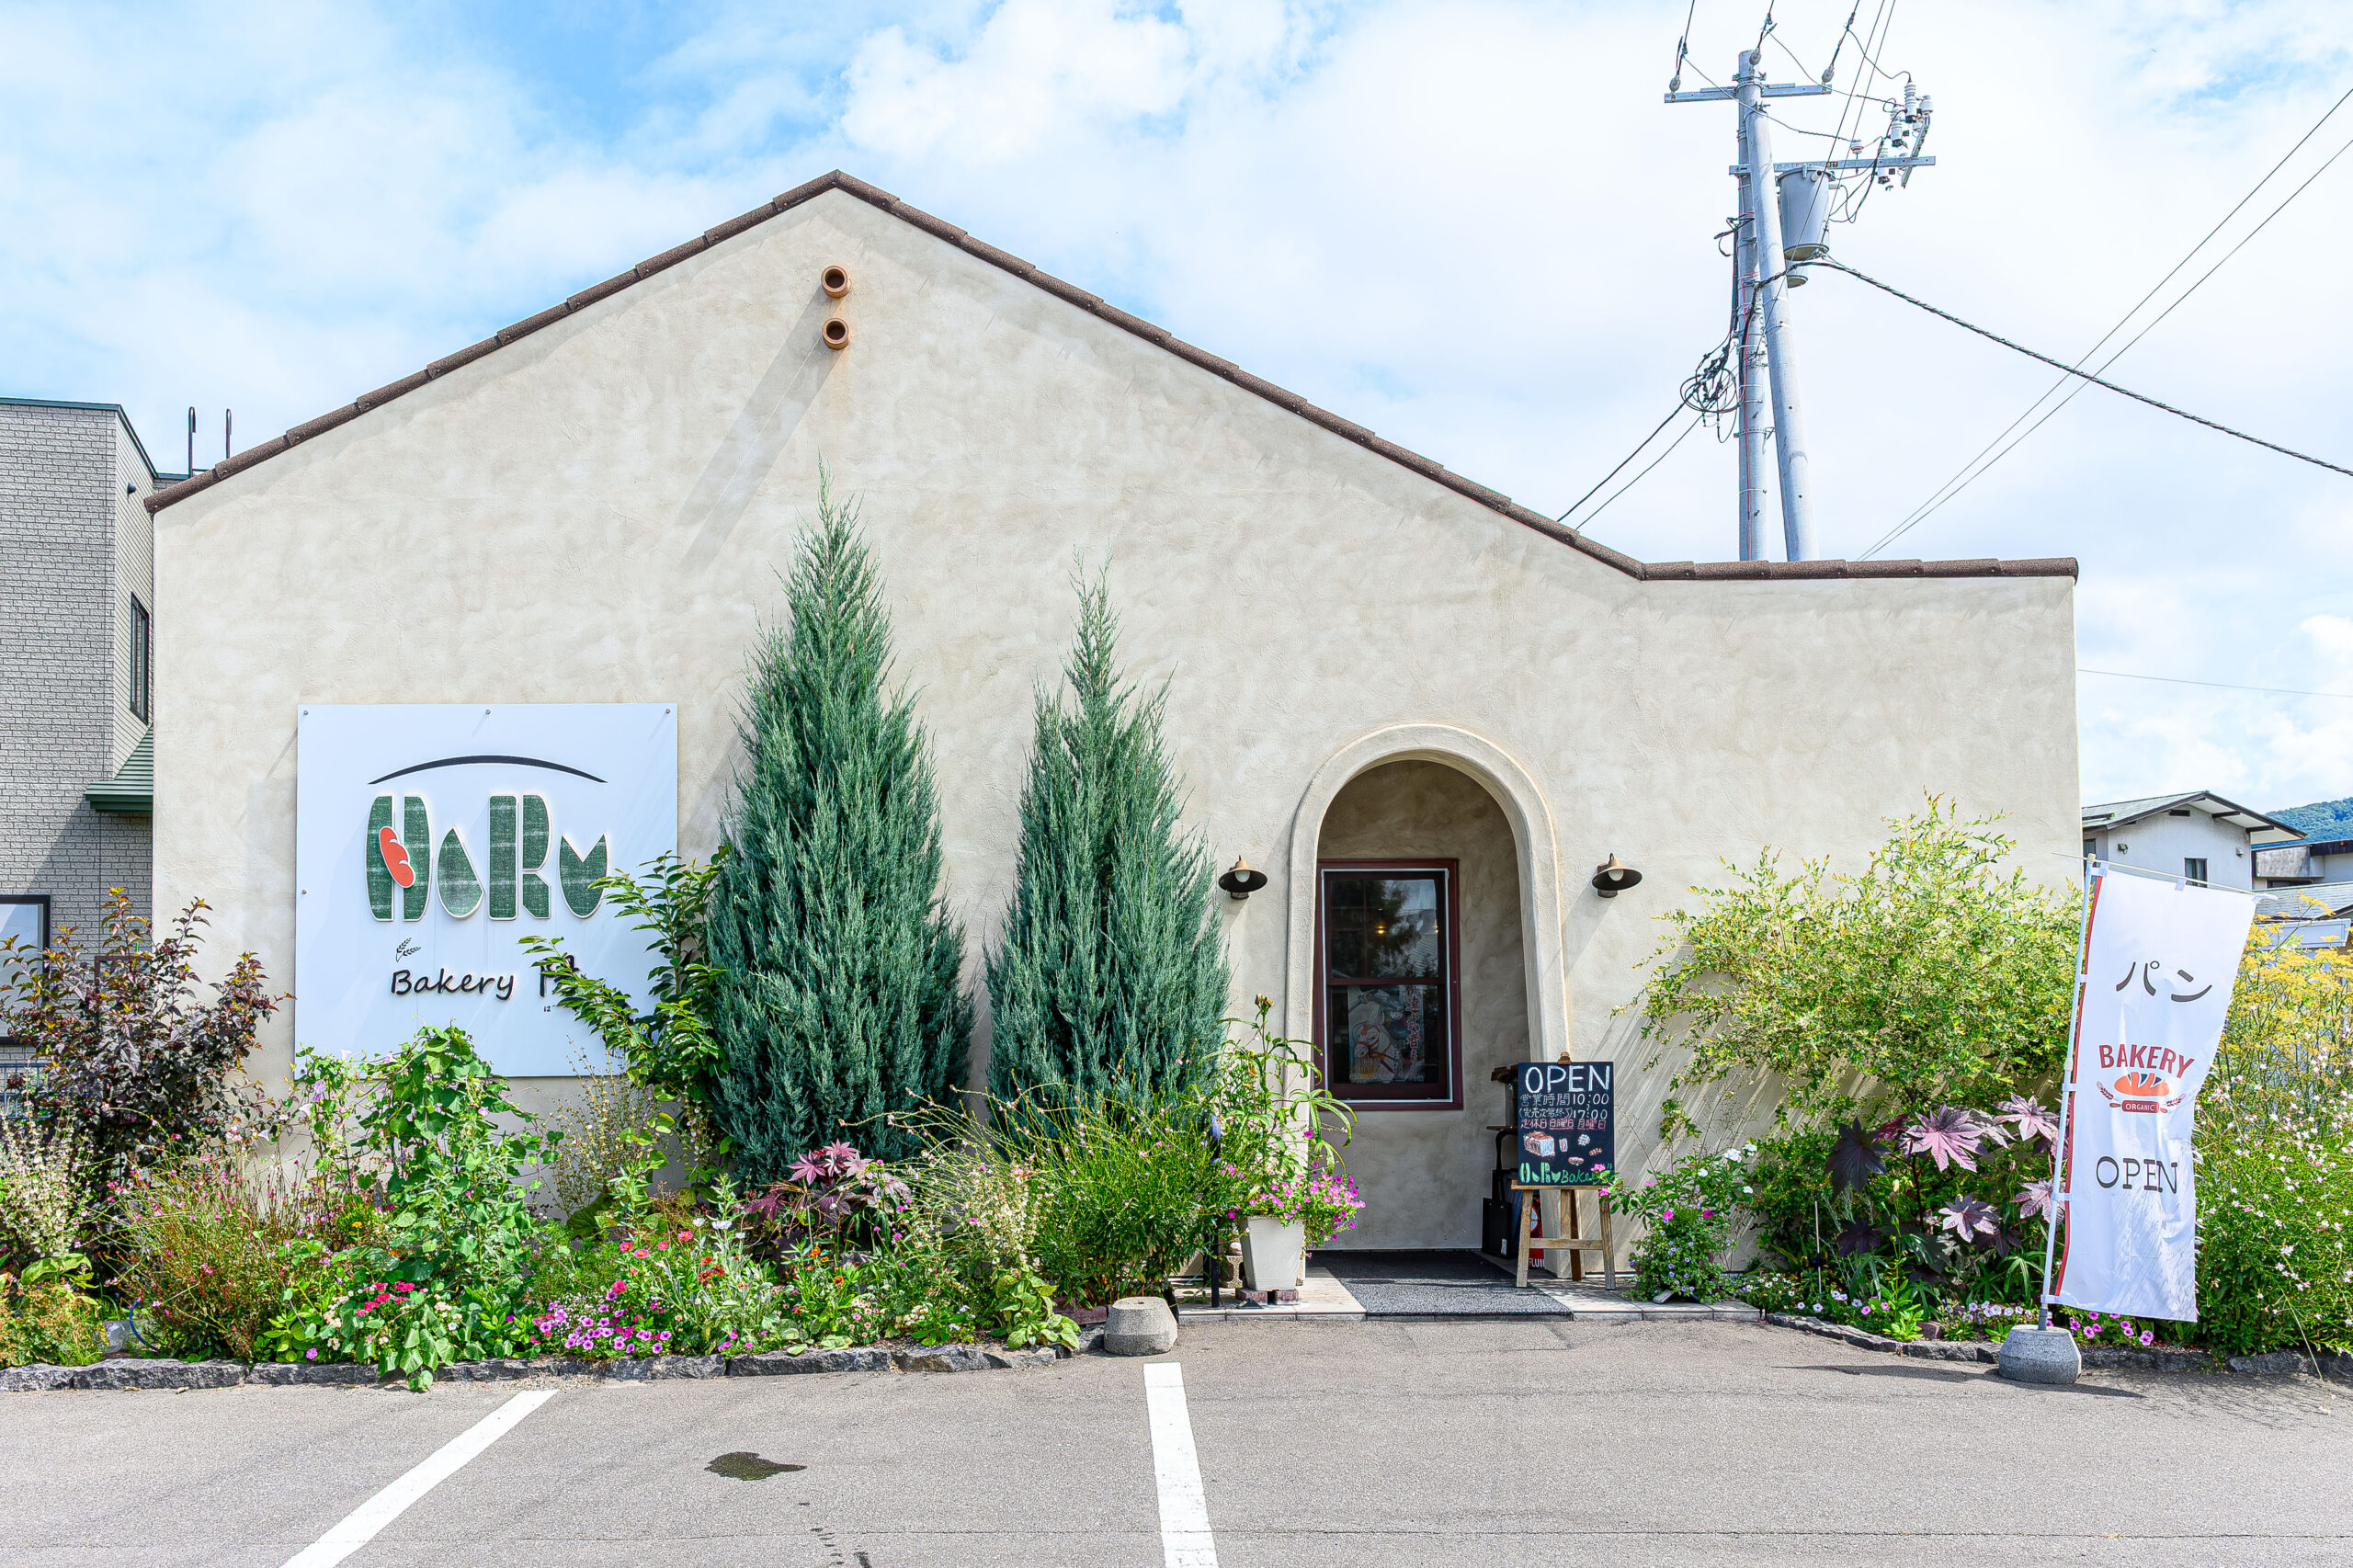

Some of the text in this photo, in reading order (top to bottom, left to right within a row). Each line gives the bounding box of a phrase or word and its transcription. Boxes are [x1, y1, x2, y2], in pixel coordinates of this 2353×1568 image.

[391, 968, 514, 1001] Bakery
[2116, 961, 2212, 1003] パン
[2098, 1044, 2195, 1079] BAKERY
[1526, 1065, 1610, 1093] OPEN
[1520, 1093, 1609, 1107] 営業時間 10:00
[1573, 1109, 1608, 1119] 17:00
[2125, 1102, 2155, 1113] ORGANIC
[2096, 1156, 2178, 1194] OPEN
